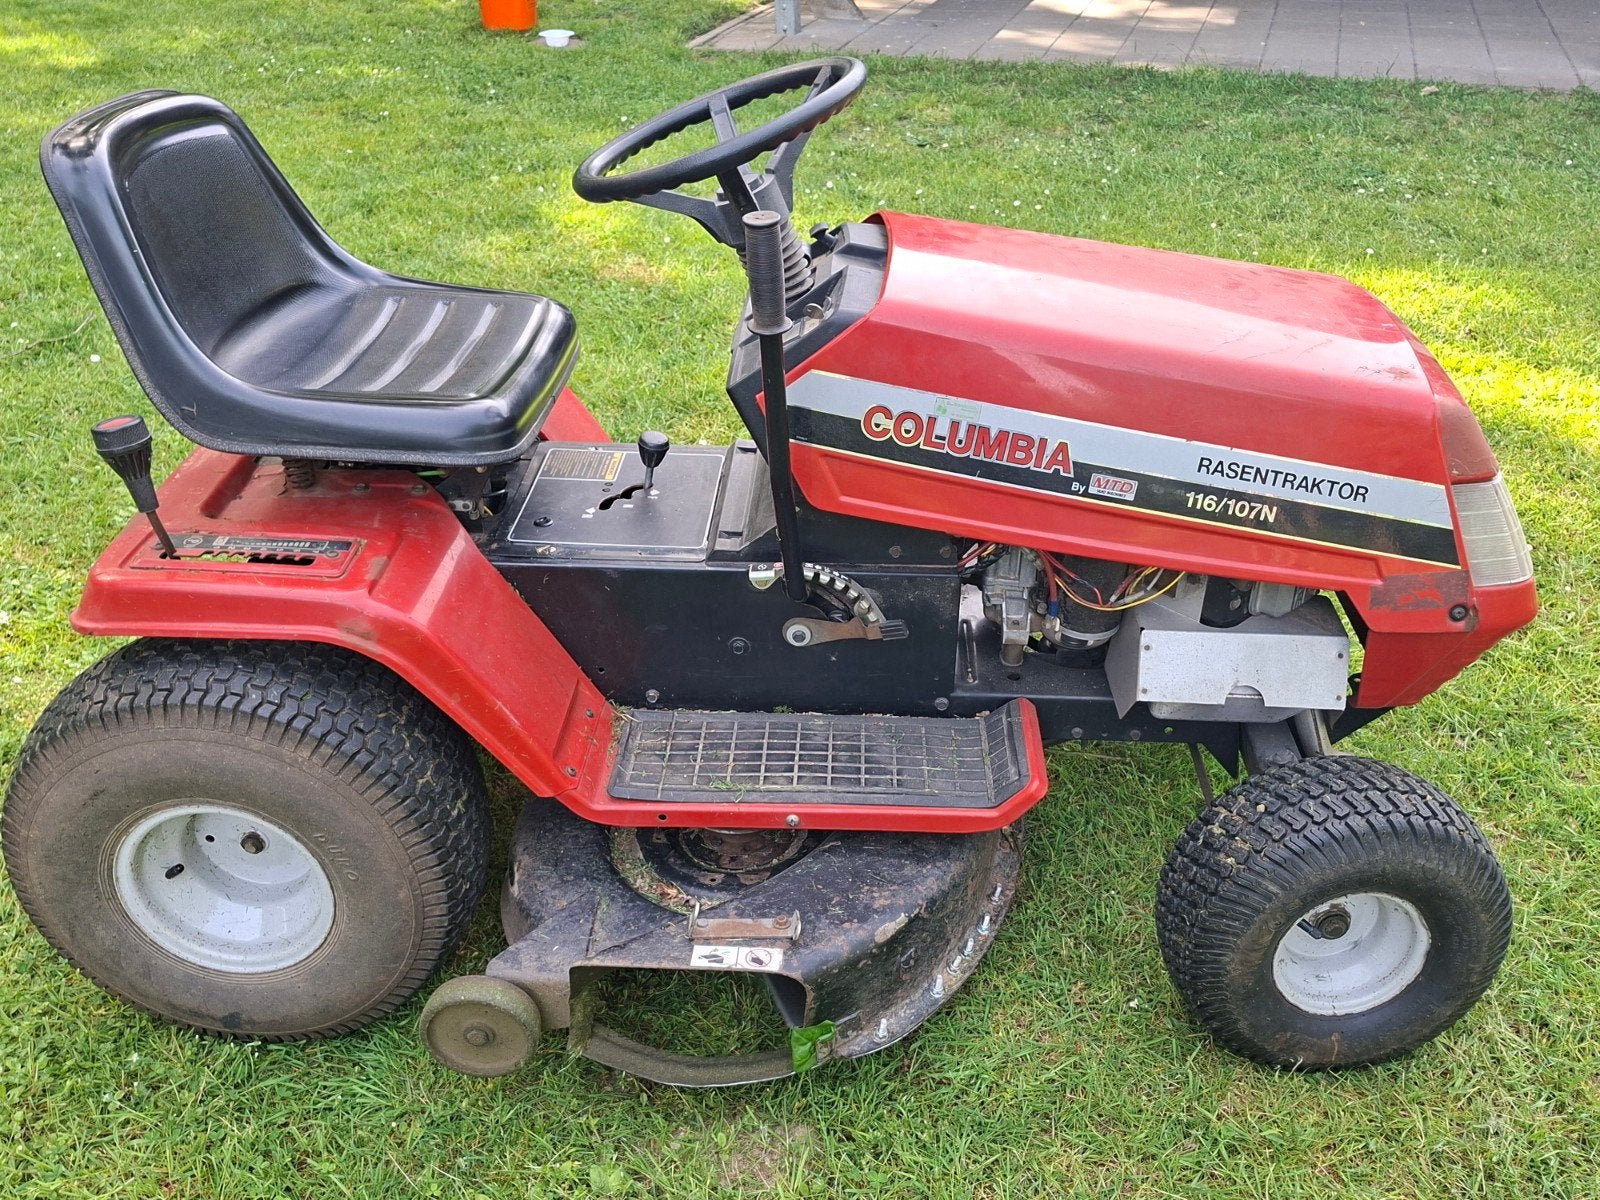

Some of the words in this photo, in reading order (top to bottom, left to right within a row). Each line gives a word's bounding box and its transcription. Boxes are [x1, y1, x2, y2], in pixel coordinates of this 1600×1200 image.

[861, 405, 1074, 477] COLUMBIA
[1071, 482, 1086, 494] By
[1093, 476, 1134, 493] MTD
[1197, 457, 1369, 502] RASENTRAKTOR
[1186, 491, 1278, 523] 116/107N
